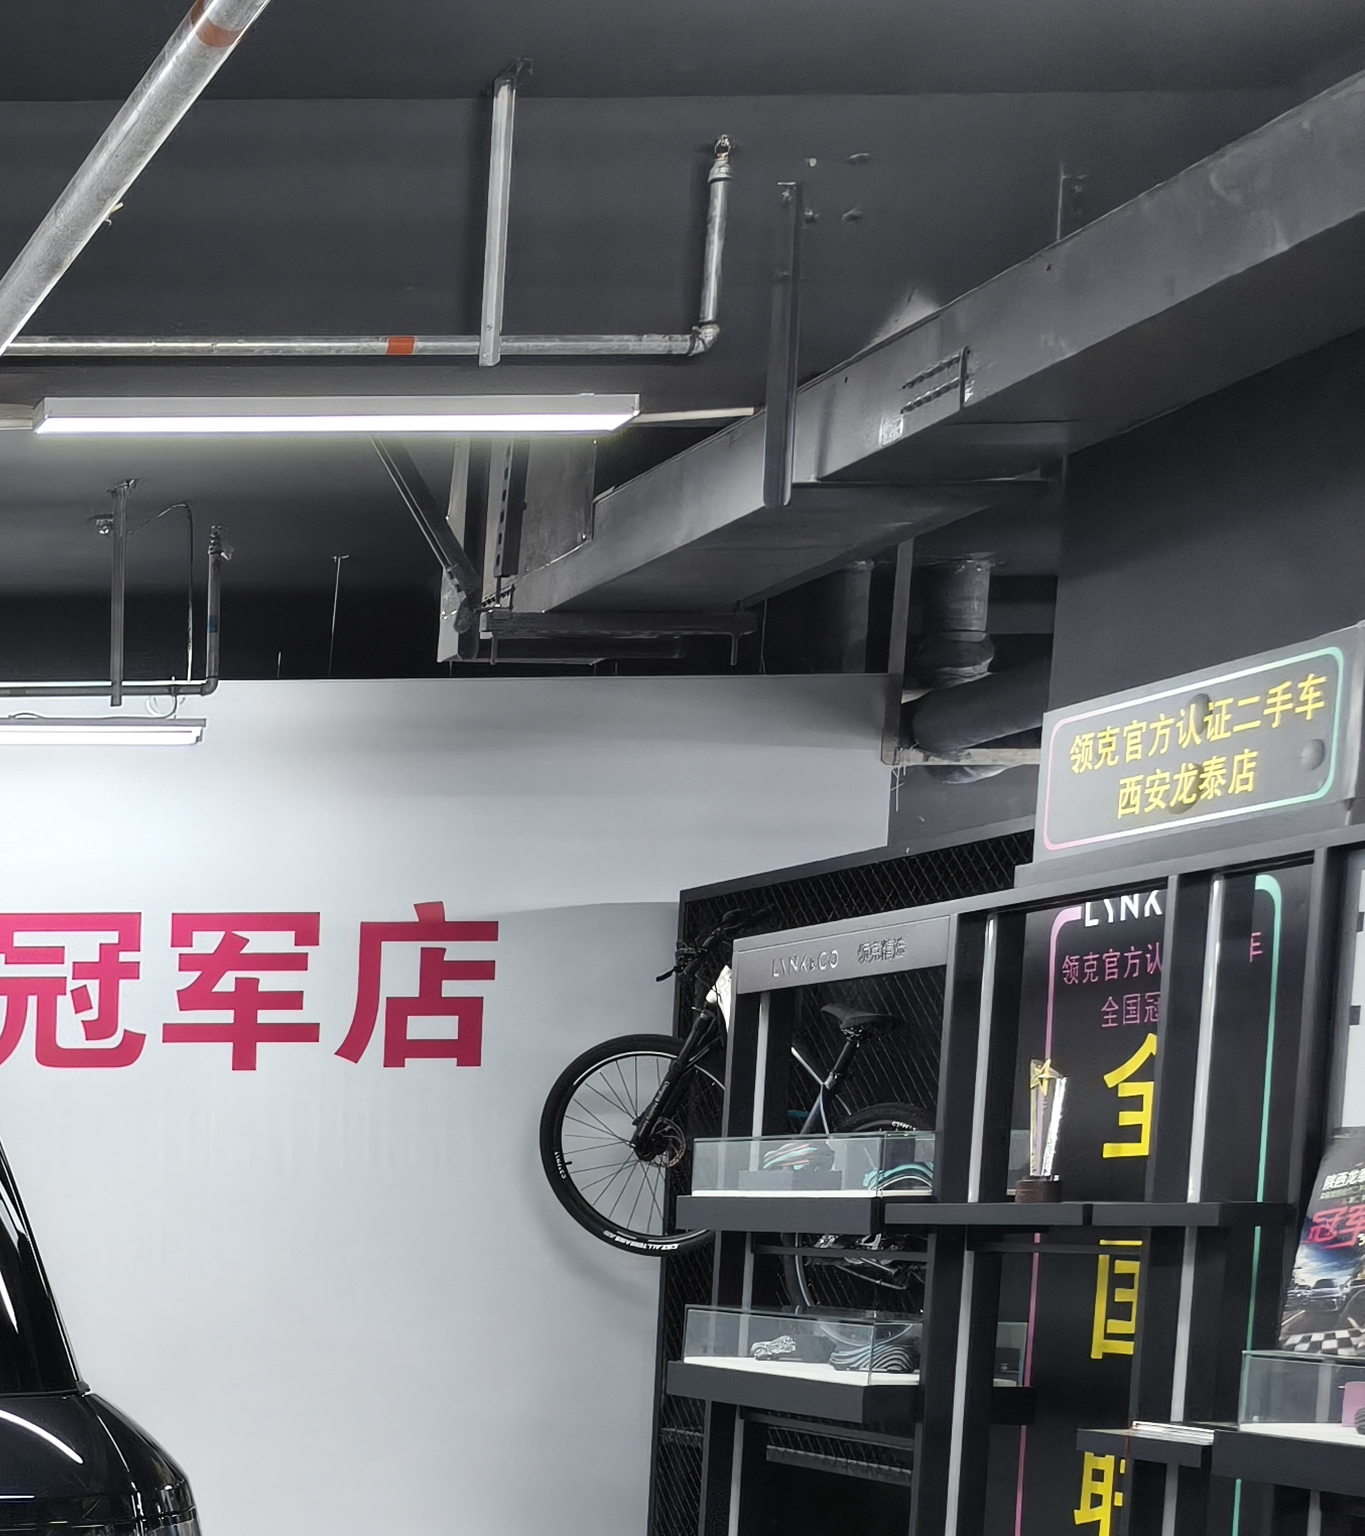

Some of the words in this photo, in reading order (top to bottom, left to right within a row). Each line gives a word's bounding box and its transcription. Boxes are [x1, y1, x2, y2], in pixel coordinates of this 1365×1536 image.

[1069, 673, 1328, 774] 领克官方认证二手车
[1117, 749, 1259, 819] 西安龙泰店
